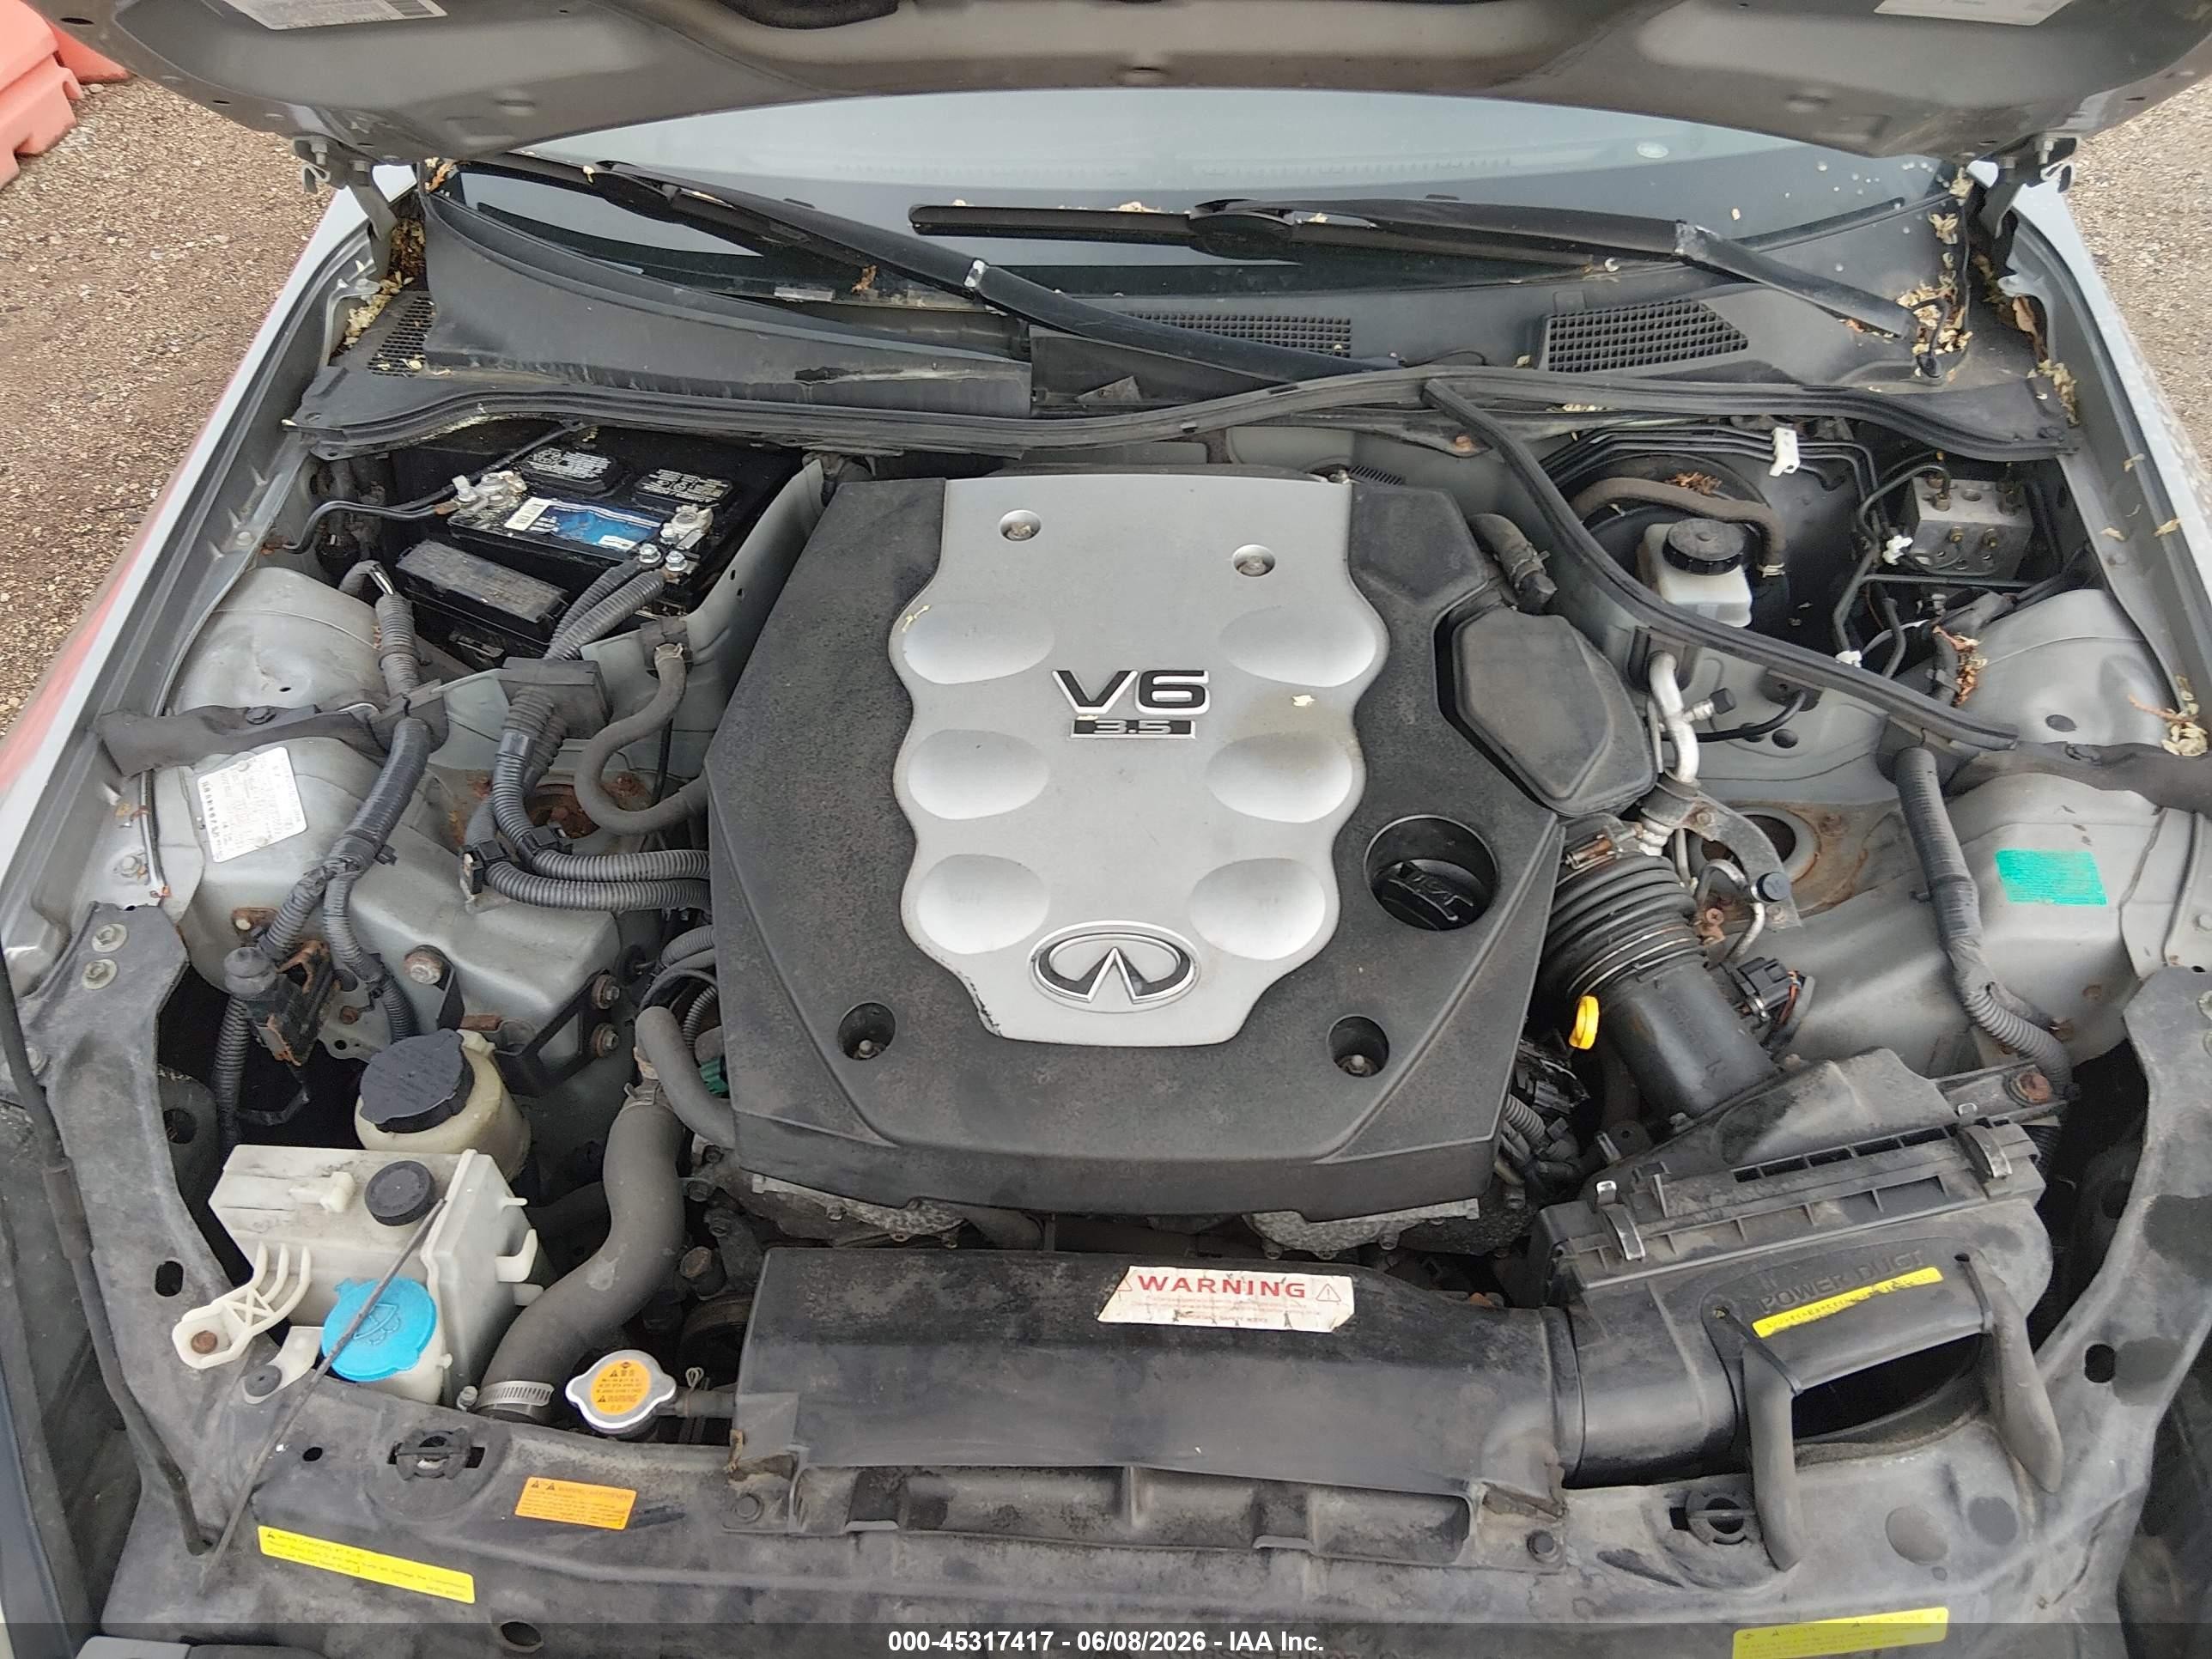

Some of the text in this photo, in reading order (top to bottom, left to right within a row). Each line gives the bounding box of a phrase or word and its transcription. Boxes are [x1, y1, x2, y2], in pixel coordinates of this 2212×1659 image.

[1052, 670, 1210, 715] V6
[1092, 719, 1171, 735] 3.5
[1138, 1275, 1306, 1298] WARNING
[1759, 1275, 1846, 1314] POWER
